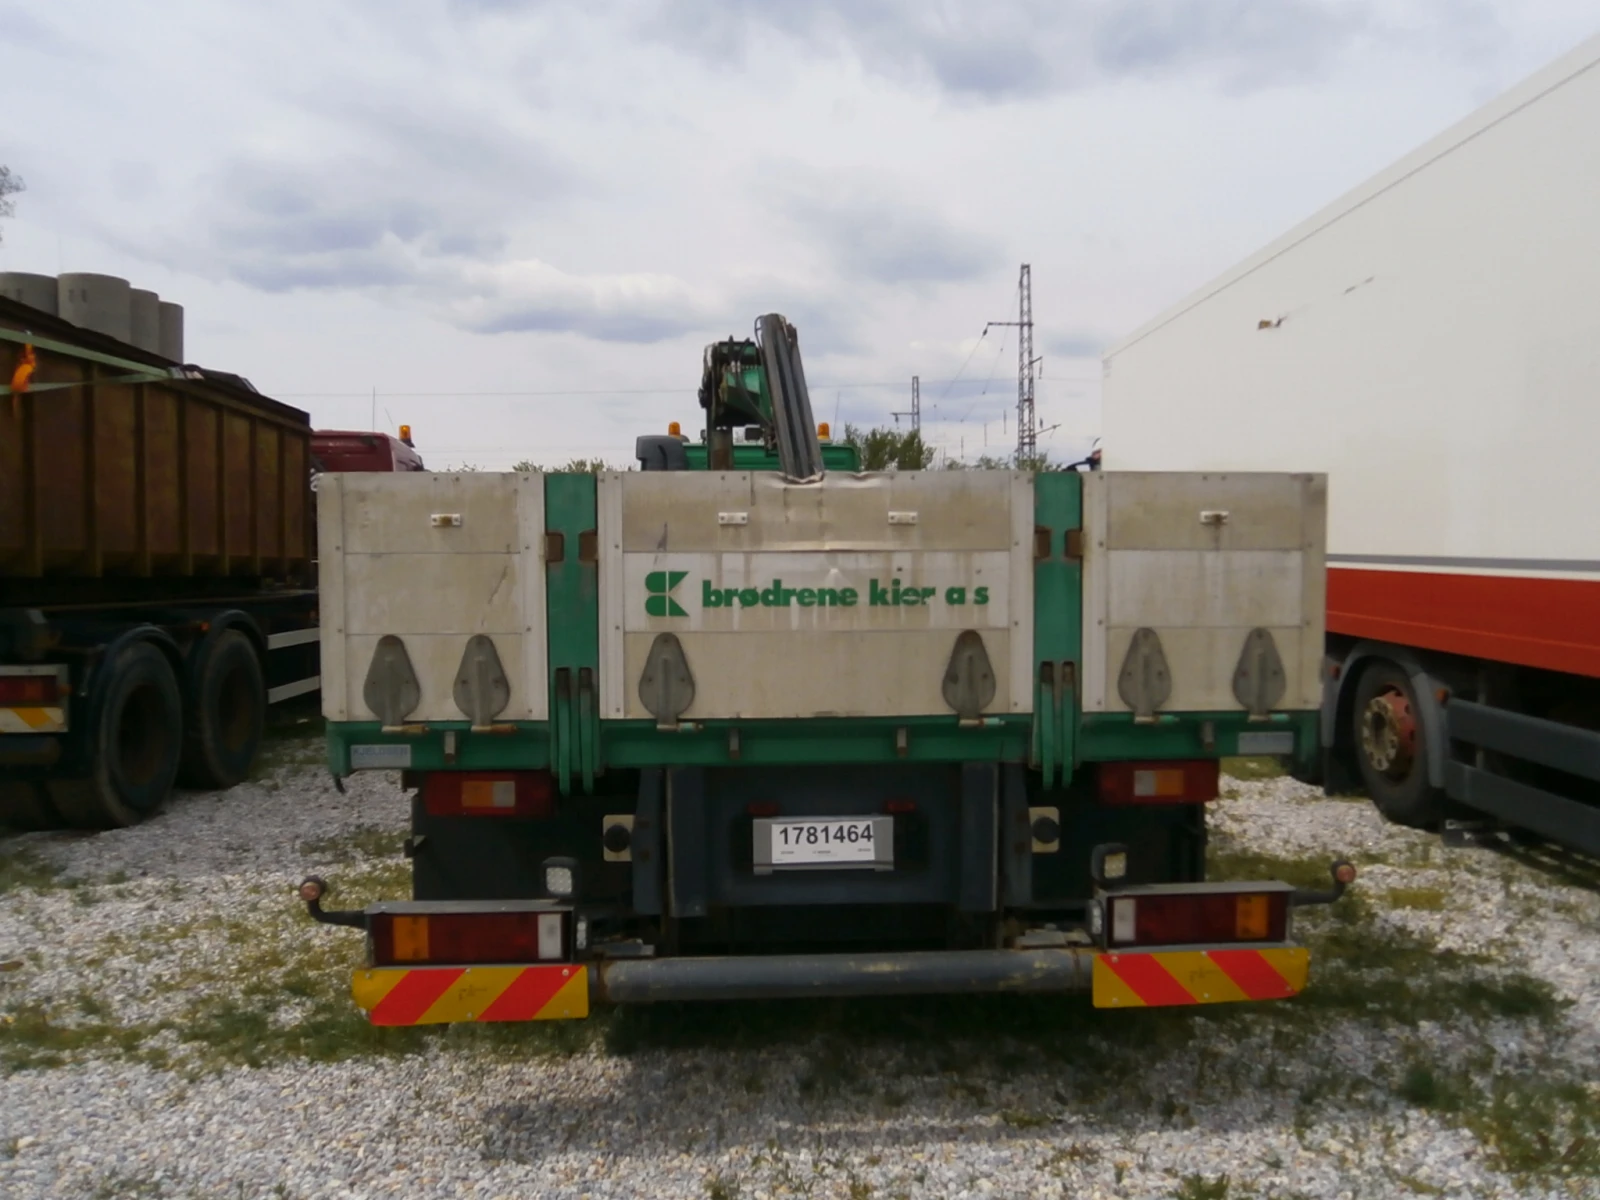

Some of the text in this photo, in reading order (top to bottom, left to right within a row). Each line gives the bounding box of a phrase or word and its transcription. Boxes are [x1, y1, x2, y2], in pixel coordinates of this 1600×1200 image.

[702, 579, 858, 608] brødrene
[869, 578, 936, 606] kier
[779, 824, 873, 845] 1781464
